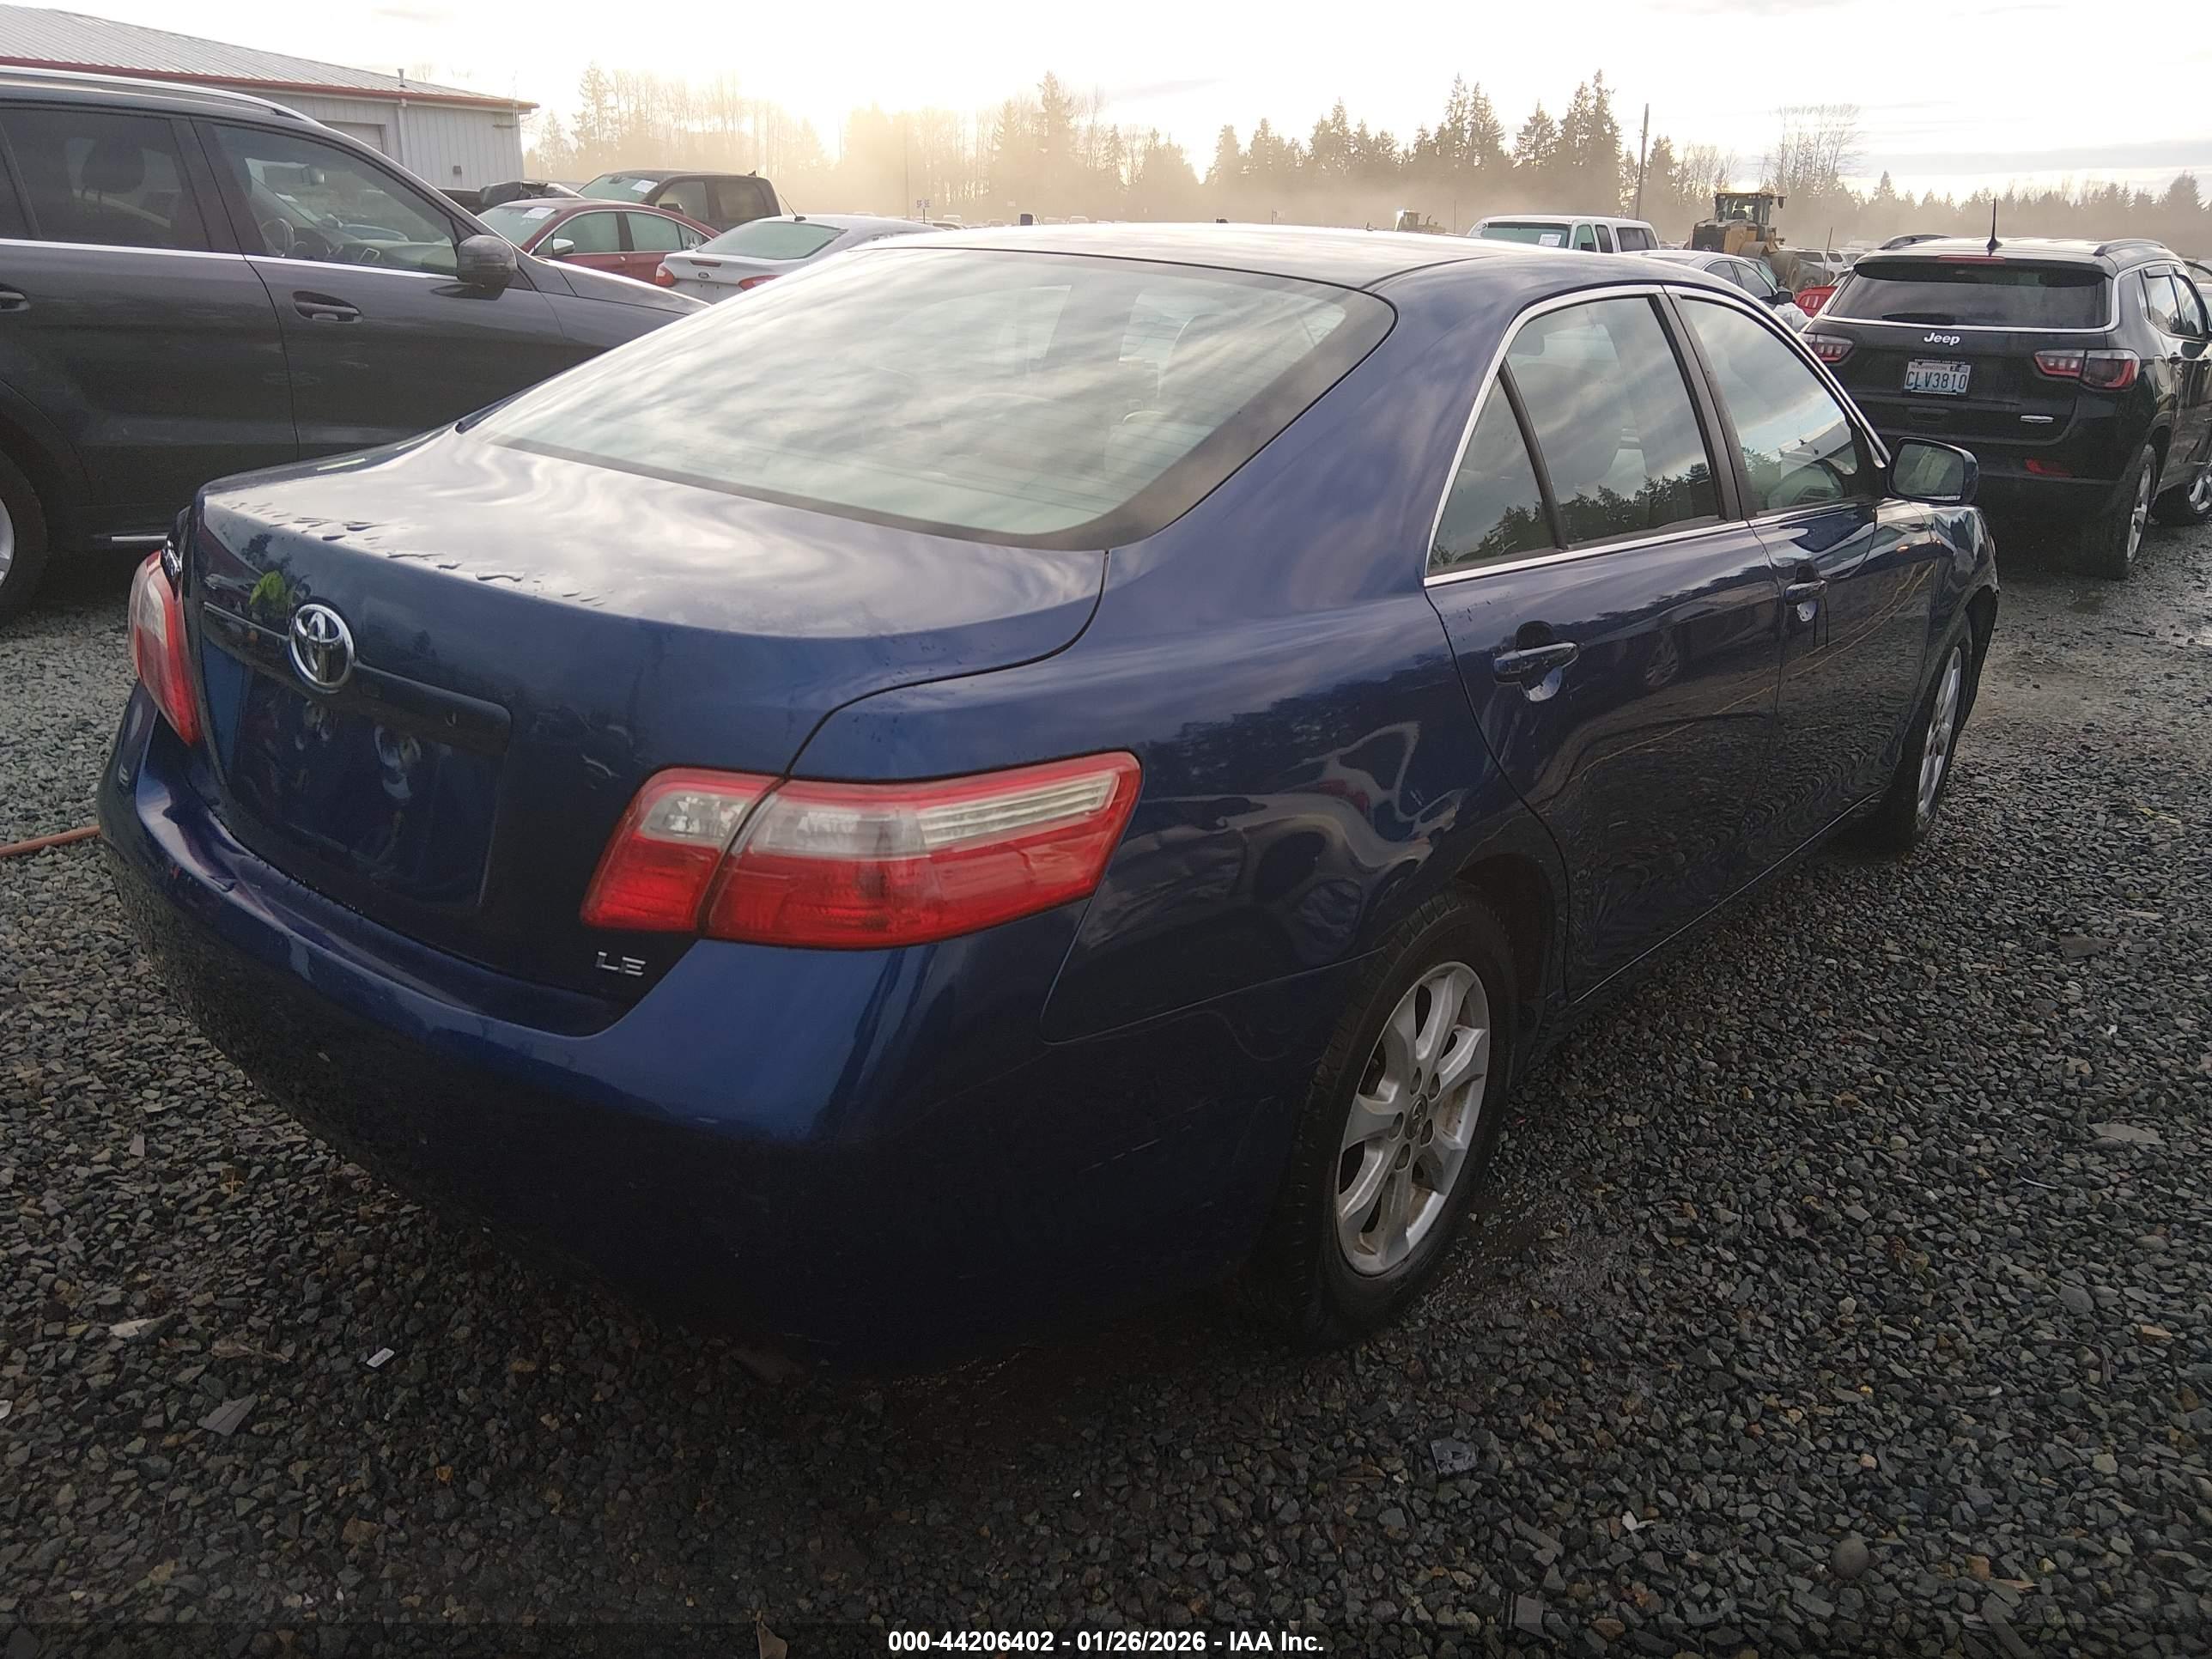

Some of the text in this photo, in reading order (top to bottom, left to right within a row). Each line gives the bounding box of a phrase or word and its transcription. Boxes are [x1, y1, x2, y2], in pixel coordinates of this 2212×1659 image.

[1923, 332, 1960, 345] Jeep
[1905, 371, 1967, 390] CLV3810
[595, 951, 646, 976] LE
